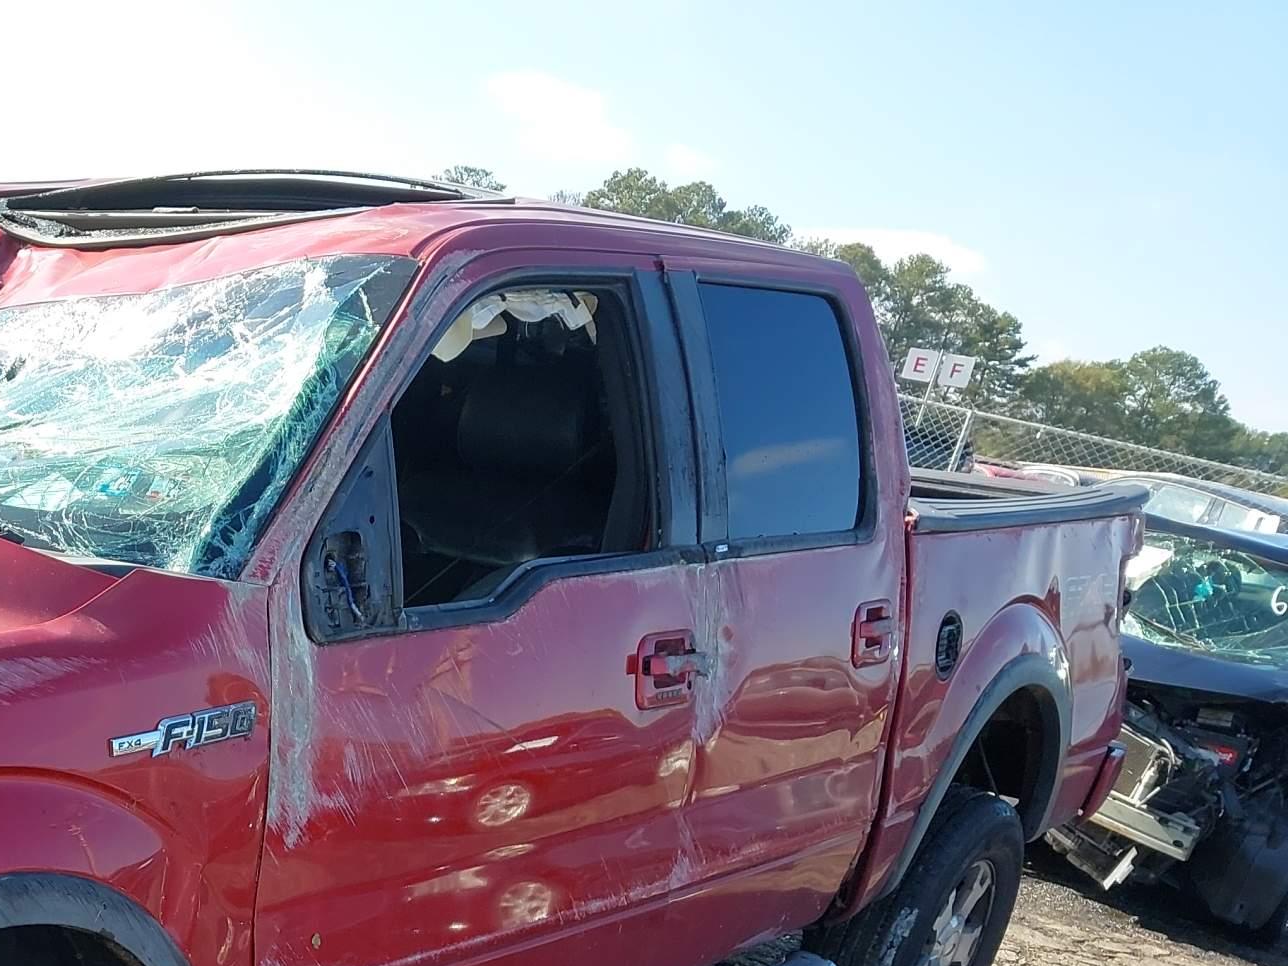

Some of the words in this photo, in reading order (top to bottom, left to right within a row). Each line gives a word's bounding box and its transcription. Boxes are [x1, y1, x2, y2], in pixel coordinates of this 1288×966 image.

[912, 356, 928, 374] E
[948, 362, 965, 379] F
[1270, 585, 1288, 616] 6
[117, 737, 142, 752] FX4
